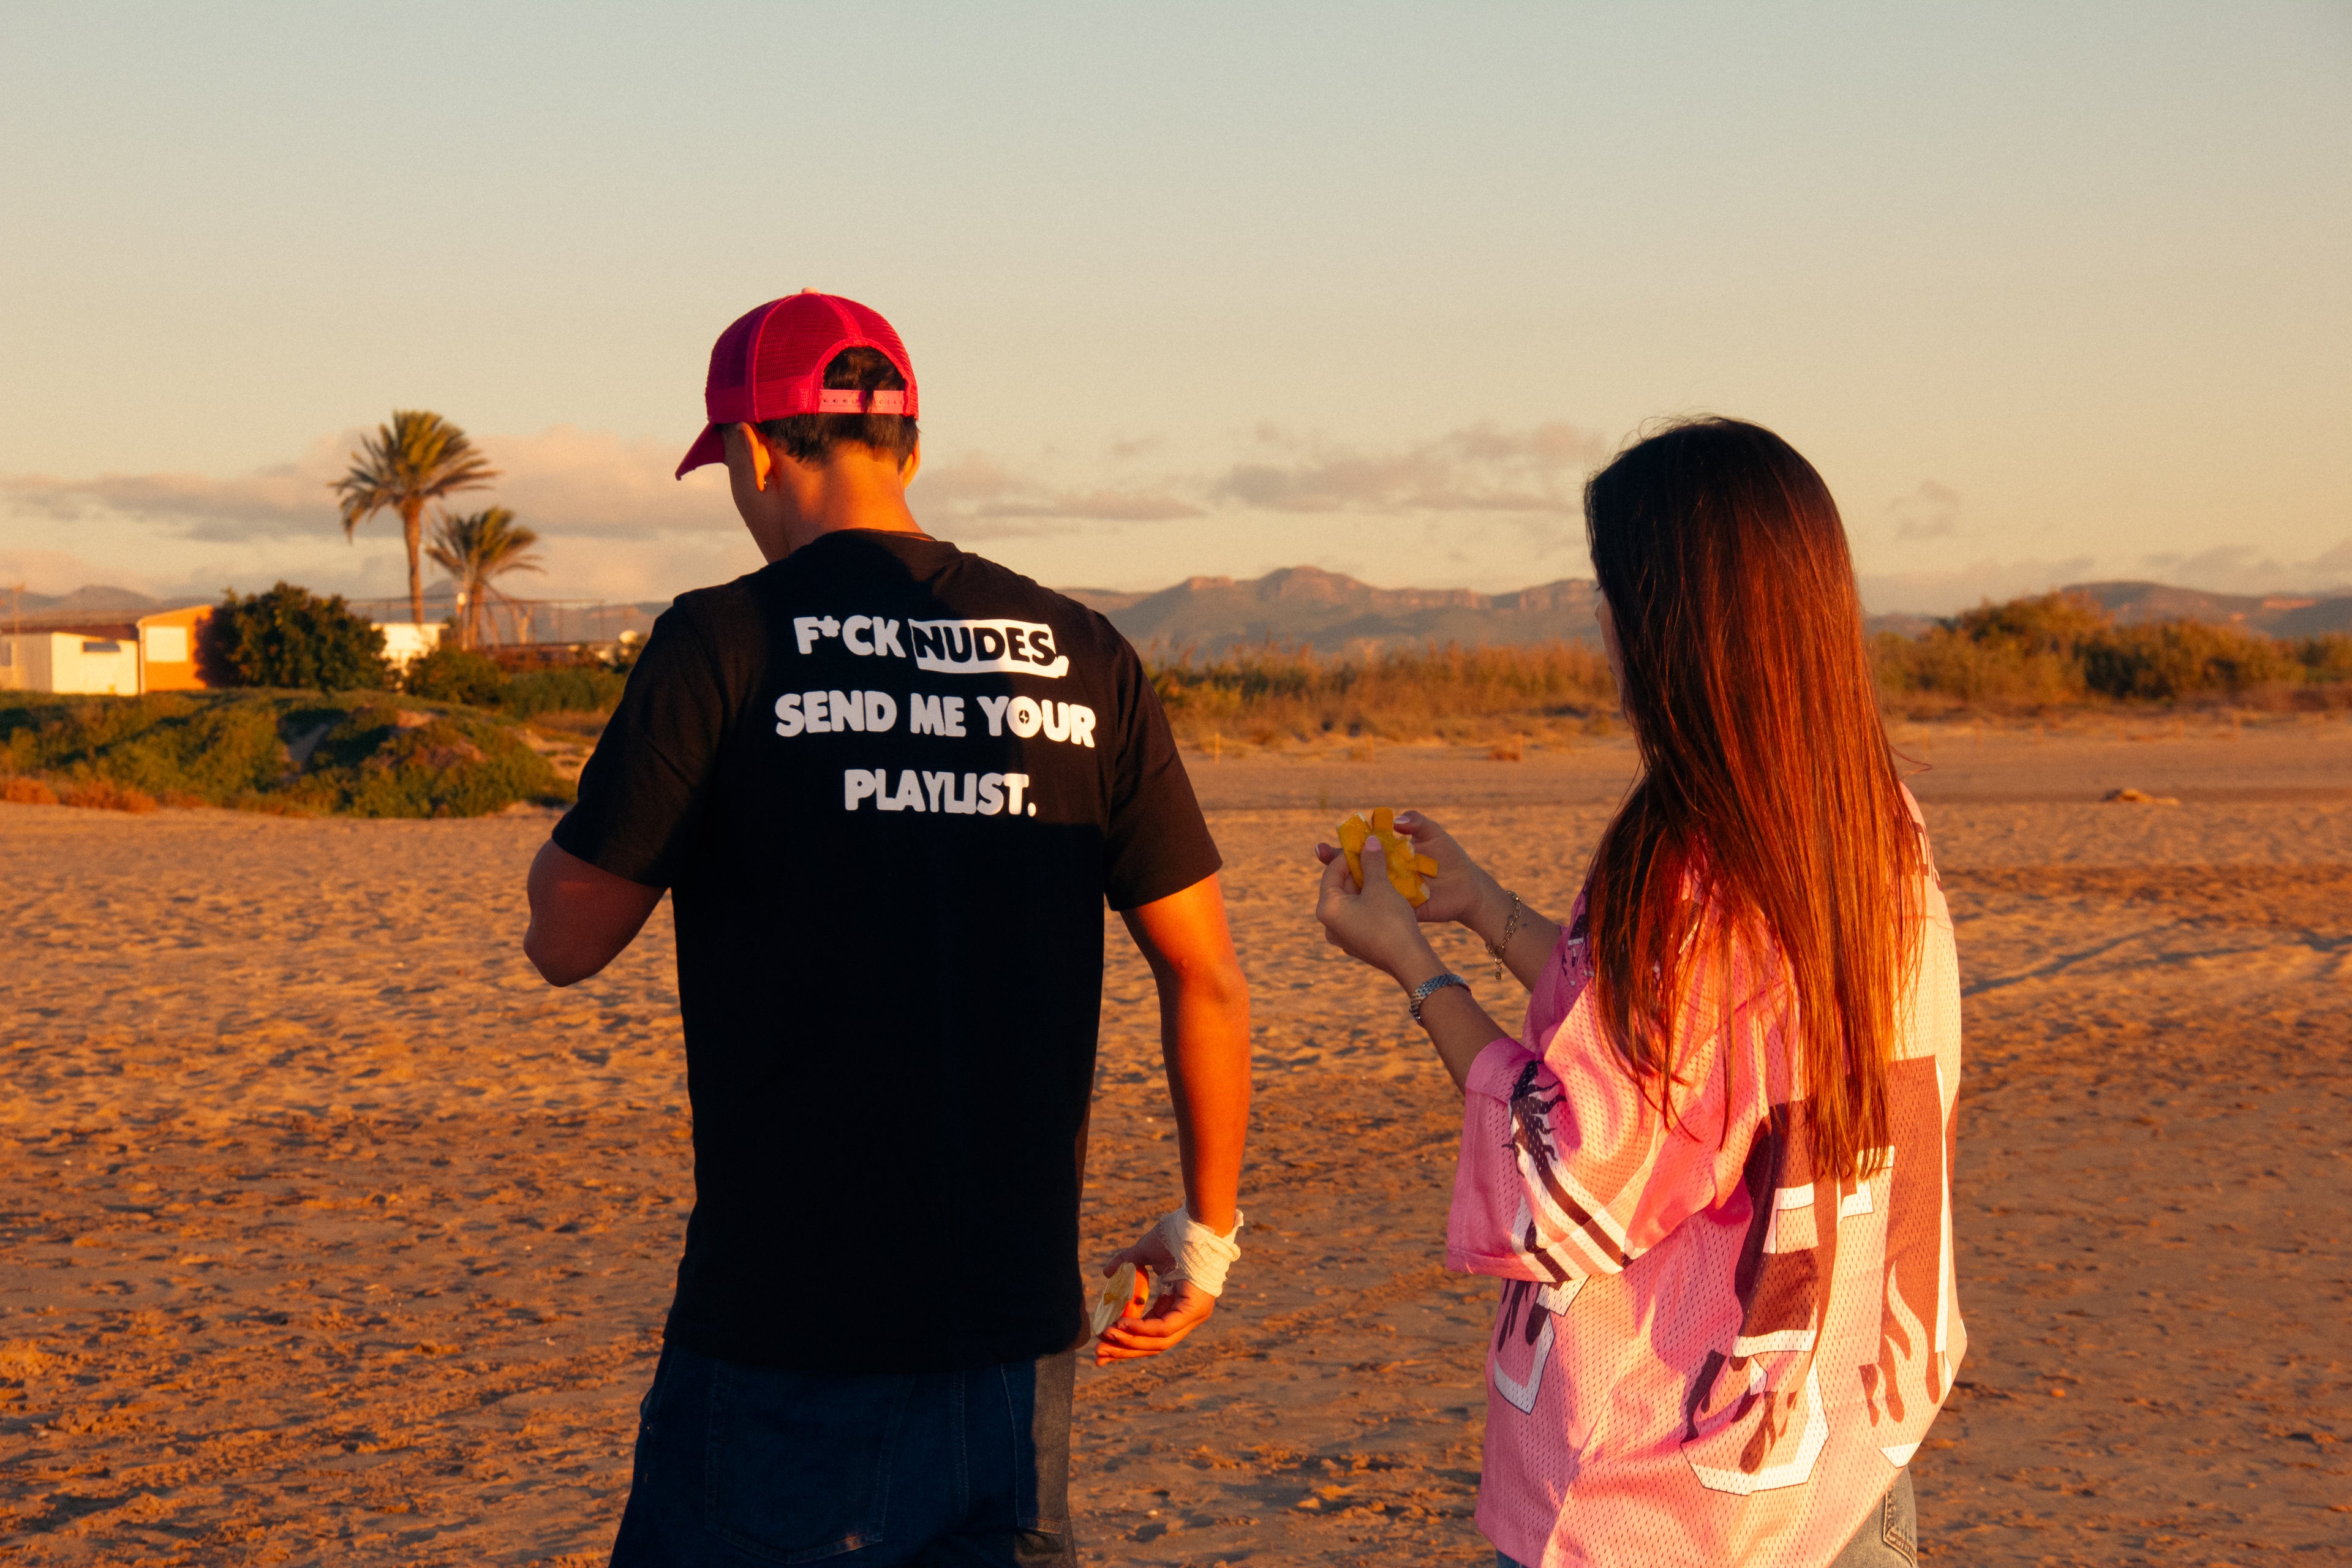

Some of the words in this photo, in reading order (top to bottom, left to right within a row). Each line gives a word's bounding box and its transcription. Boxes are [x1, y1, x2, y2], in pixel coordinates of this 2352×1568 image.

[775, 690, 897, 737] SEND
[910, 693, 967, 737] ME
[977, 695, 1096, 748] YOUR
[844, 769, 1037, 817] PLAYLIST.
